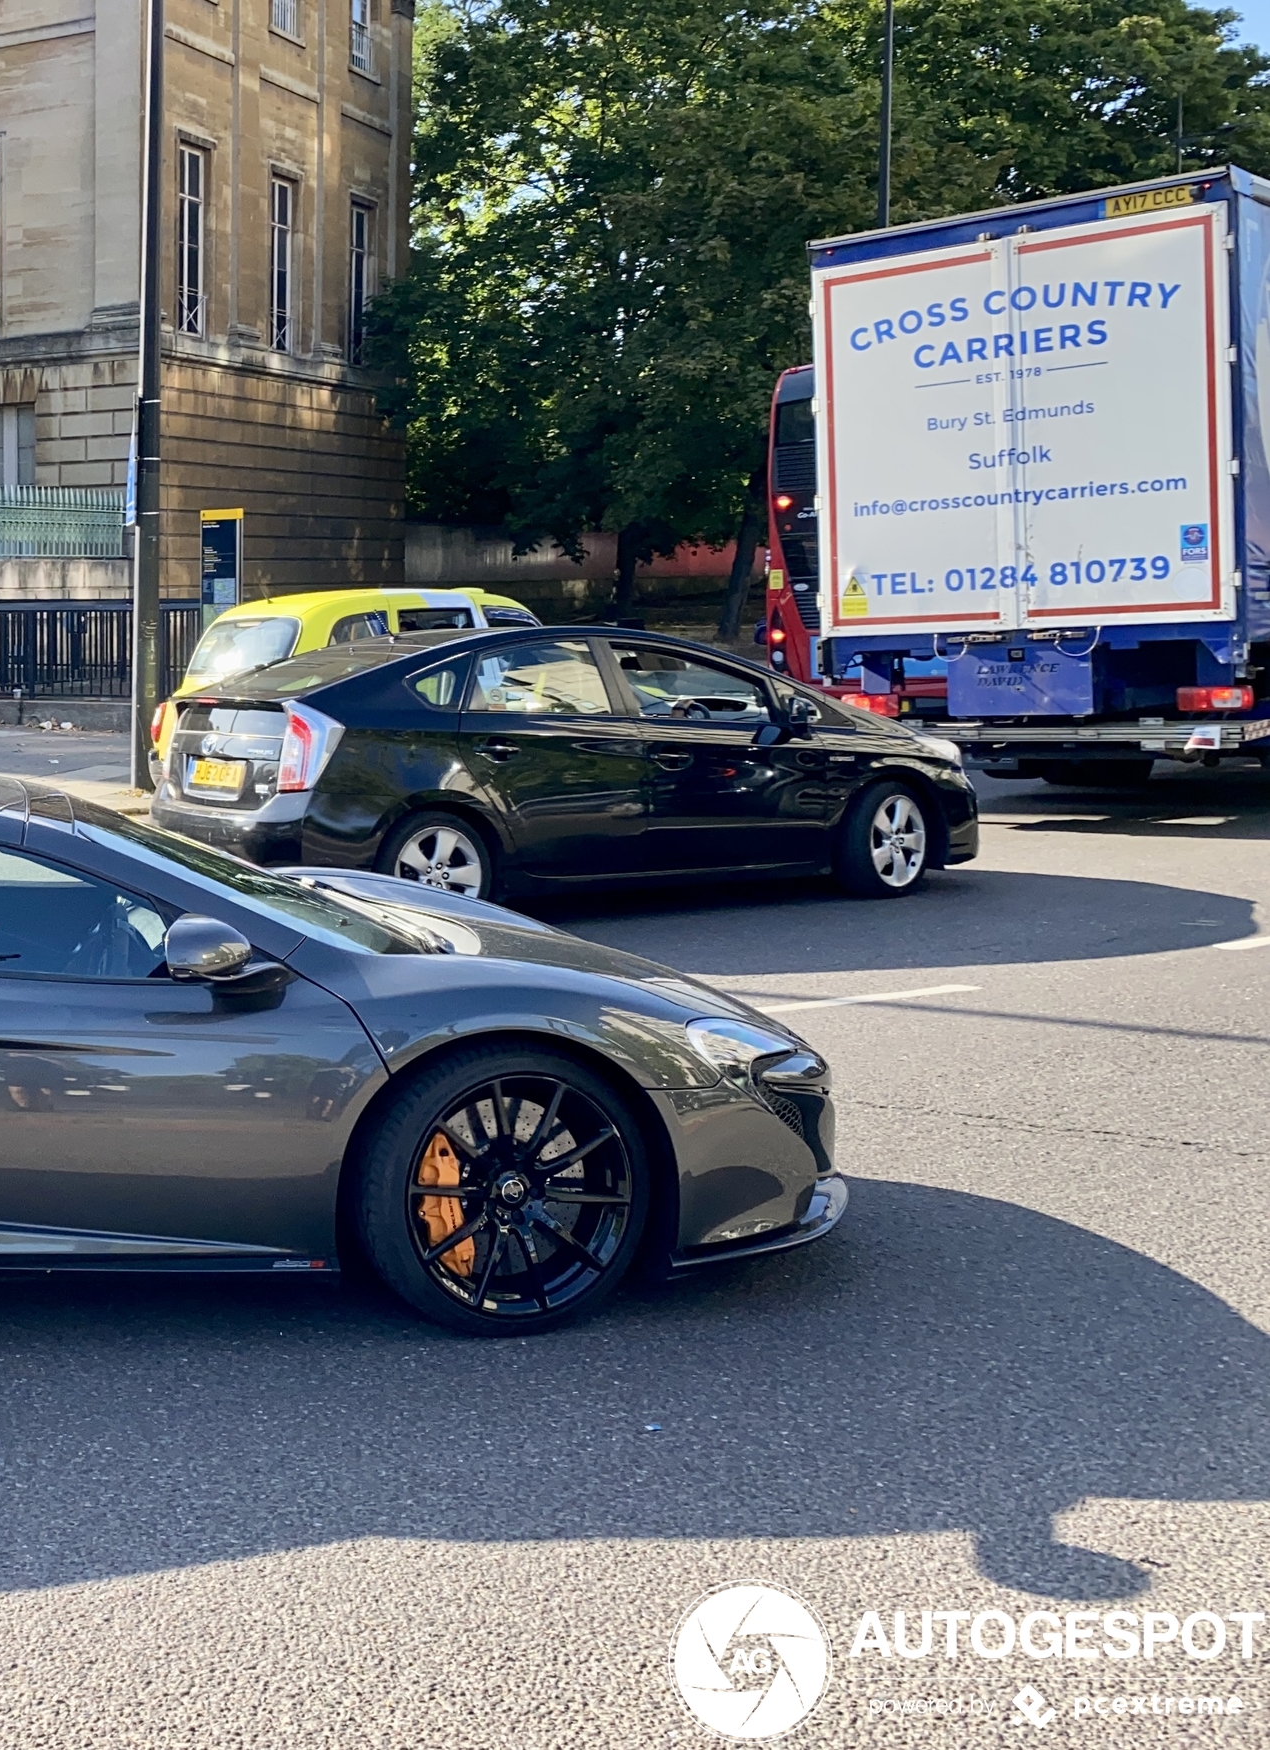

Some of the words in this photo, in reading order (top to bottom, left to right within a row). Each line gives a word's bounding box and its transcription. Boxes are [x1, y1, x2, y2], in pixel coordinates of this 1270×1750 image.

[1113, 194, 1148, 213] AY17
[1153, 187, 1186, 206] CCC
[850, 297, 969, 351] CROSS
[983, 281, 1182, 315] COUNTRY
[913, 319, 1108, 368] CARRIERS
[975, 372, 1005, 385] EST.
[1010, 367, 1042, 380] 1978
[927, 417, 968, 432] Bury
[973, 412, 996, 426] St.
[1002, 400, 1095, 423] Edmunds
[968, 445, 1052, 470] Suffolk
[853, 477, 1187, 518] info@crosscountrycarriers.com
[1182, 547, 1207, 556] FORS
[871, 572, 934, 596] TEL:
[945, 564, 1038, 592] 01284
[1049, 555, 1170, 586] 810739
